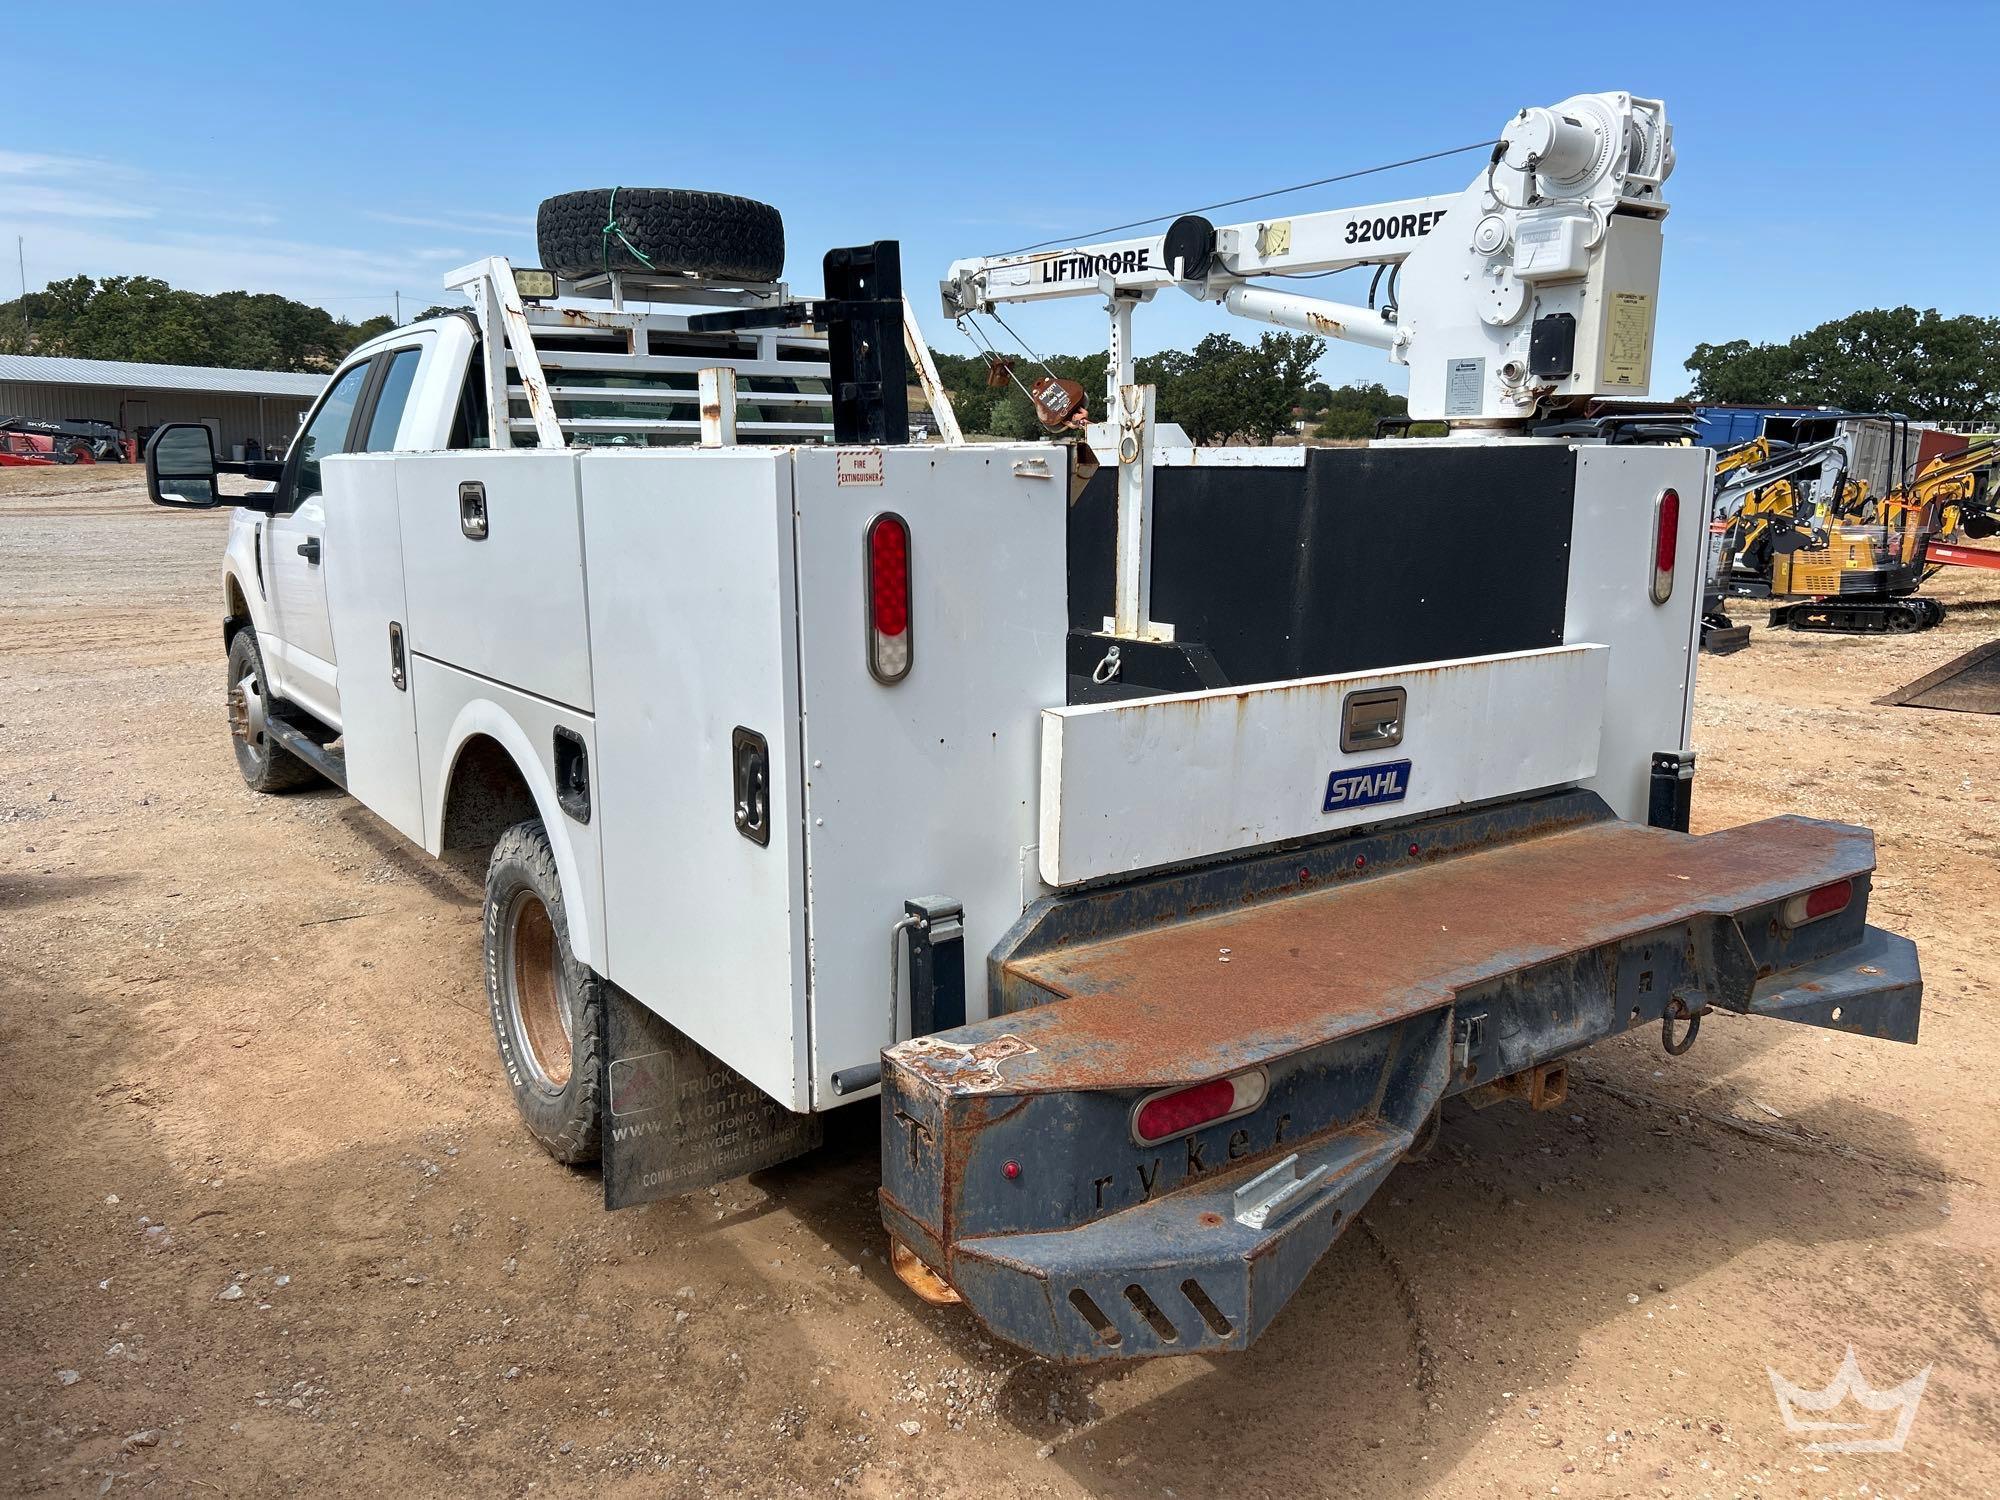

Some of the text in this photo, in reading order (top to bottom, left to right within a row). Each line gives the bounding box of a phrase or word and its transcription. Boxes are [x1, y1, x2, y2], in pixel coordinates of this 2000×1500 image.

[1043, 248, 1150, 283] LIFTMOORE
[27, 421, 61, 430] SKYJACK
[841, 473, 880, 483] EXTINGUISHER
[854, 460, 866, 469] FIRE
[1330, 771, 1402, 803] STAHL
[489, 902, 498, 935] T/A
[677, 1069, 733, 1099] TRUCK
[671, 1130, 699, 1146] SAN
[762, 1103, 777, 1117] TX
[747, 1126, 761, 1137] TX
[643, 1124, 801, 1188] COMMERCIAL VEHICLE EQUIPMENT
